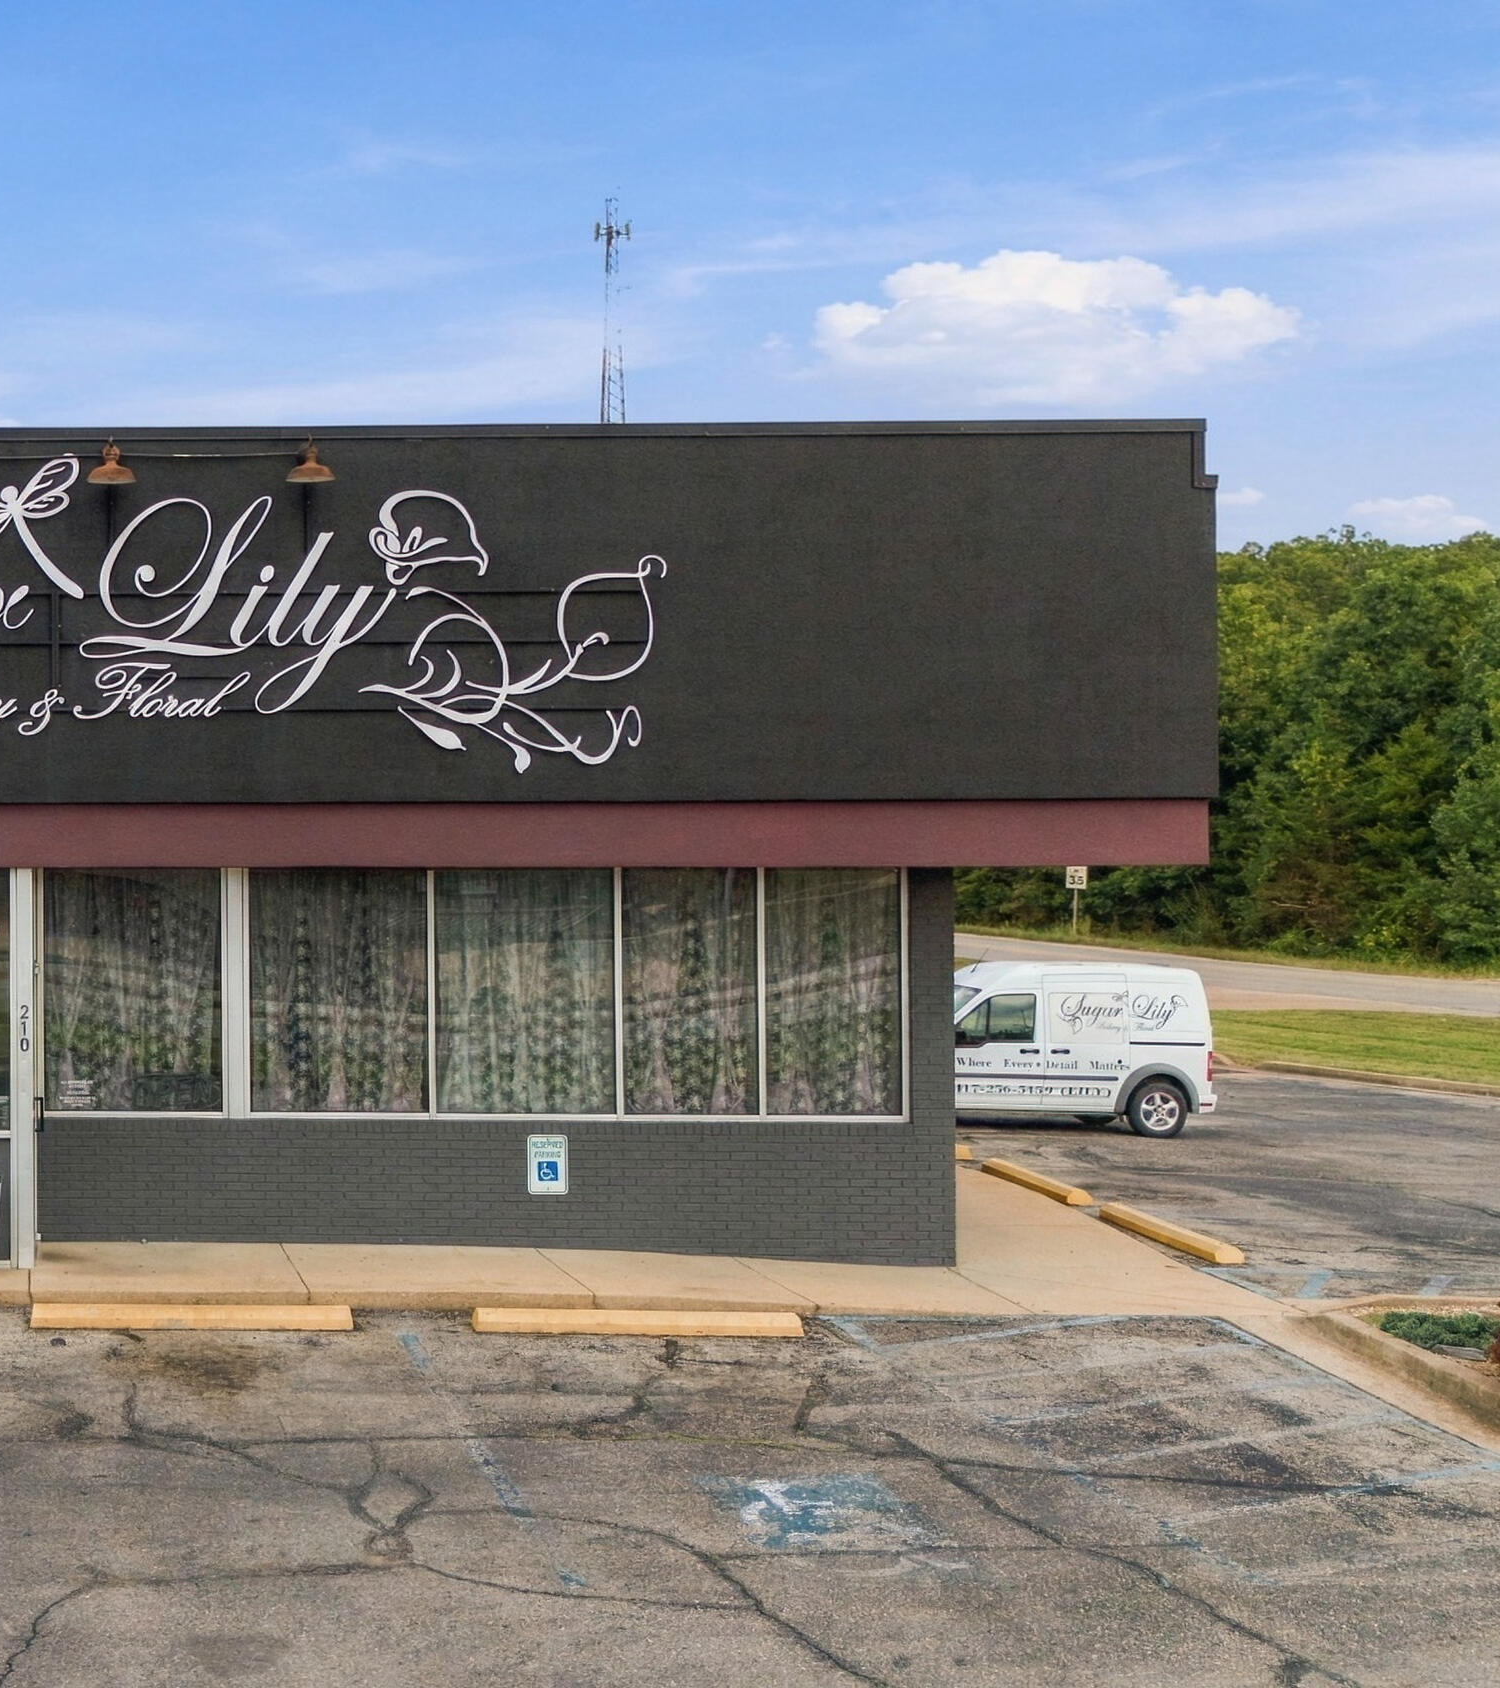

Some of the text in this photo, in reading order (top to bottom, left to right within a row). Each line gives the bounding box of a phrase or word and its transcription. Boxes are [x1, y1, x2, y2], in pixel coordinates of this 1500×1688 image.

[78, 495, 397, 714] Lily
[17, 688, 65, 736] &
[73, 662, 251, 720] Floral
[1069, 875, 1084, 886] 35
[19, 1004, 29, 1052] 210
[1060, 992, 1172, 1030] Sugar Lily
[956, 1057, 1130, 1072] Where Every Detail Matters
